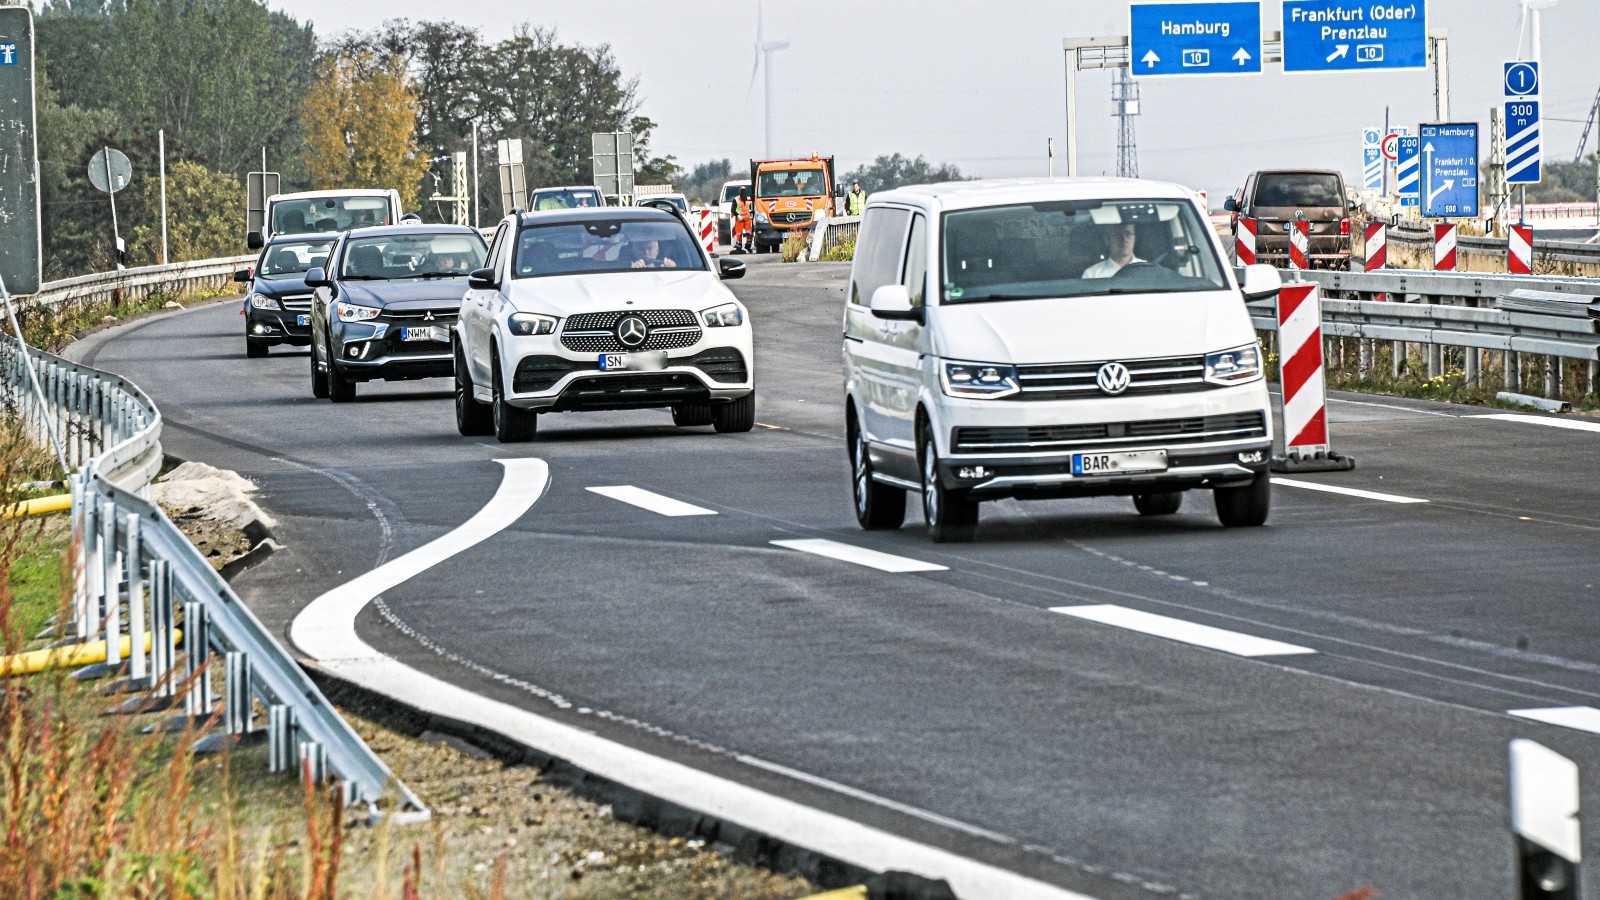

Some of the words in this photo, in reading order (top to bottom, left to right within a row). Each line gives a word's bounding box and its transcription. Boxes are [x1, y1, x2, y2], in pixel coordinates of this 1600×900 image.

[1292, 7, 1363, 22] Frankfurt
[1370, 4, 1416, 20] (Oder)
[1161, 20, 1230, 37] Hamburg
[1321, 25, 1387, 40] Prenzlau
[1190, 53, 1202, 63] 10
[1365, 48, 1376, 58] 10
[1518, 70, 1524, 87] 1
[1511, 105, 1532, 116] 300
[1440, 128, 1474, 137] Hamburg
[1402, 139, 1417, 147] 200
[1435, 158, 1463, 166] Frankfurt
[408, 329, 426, 337] NWM
[607, 356, 622, 367] SN
[1083, 456, 1109, 471] BAR
